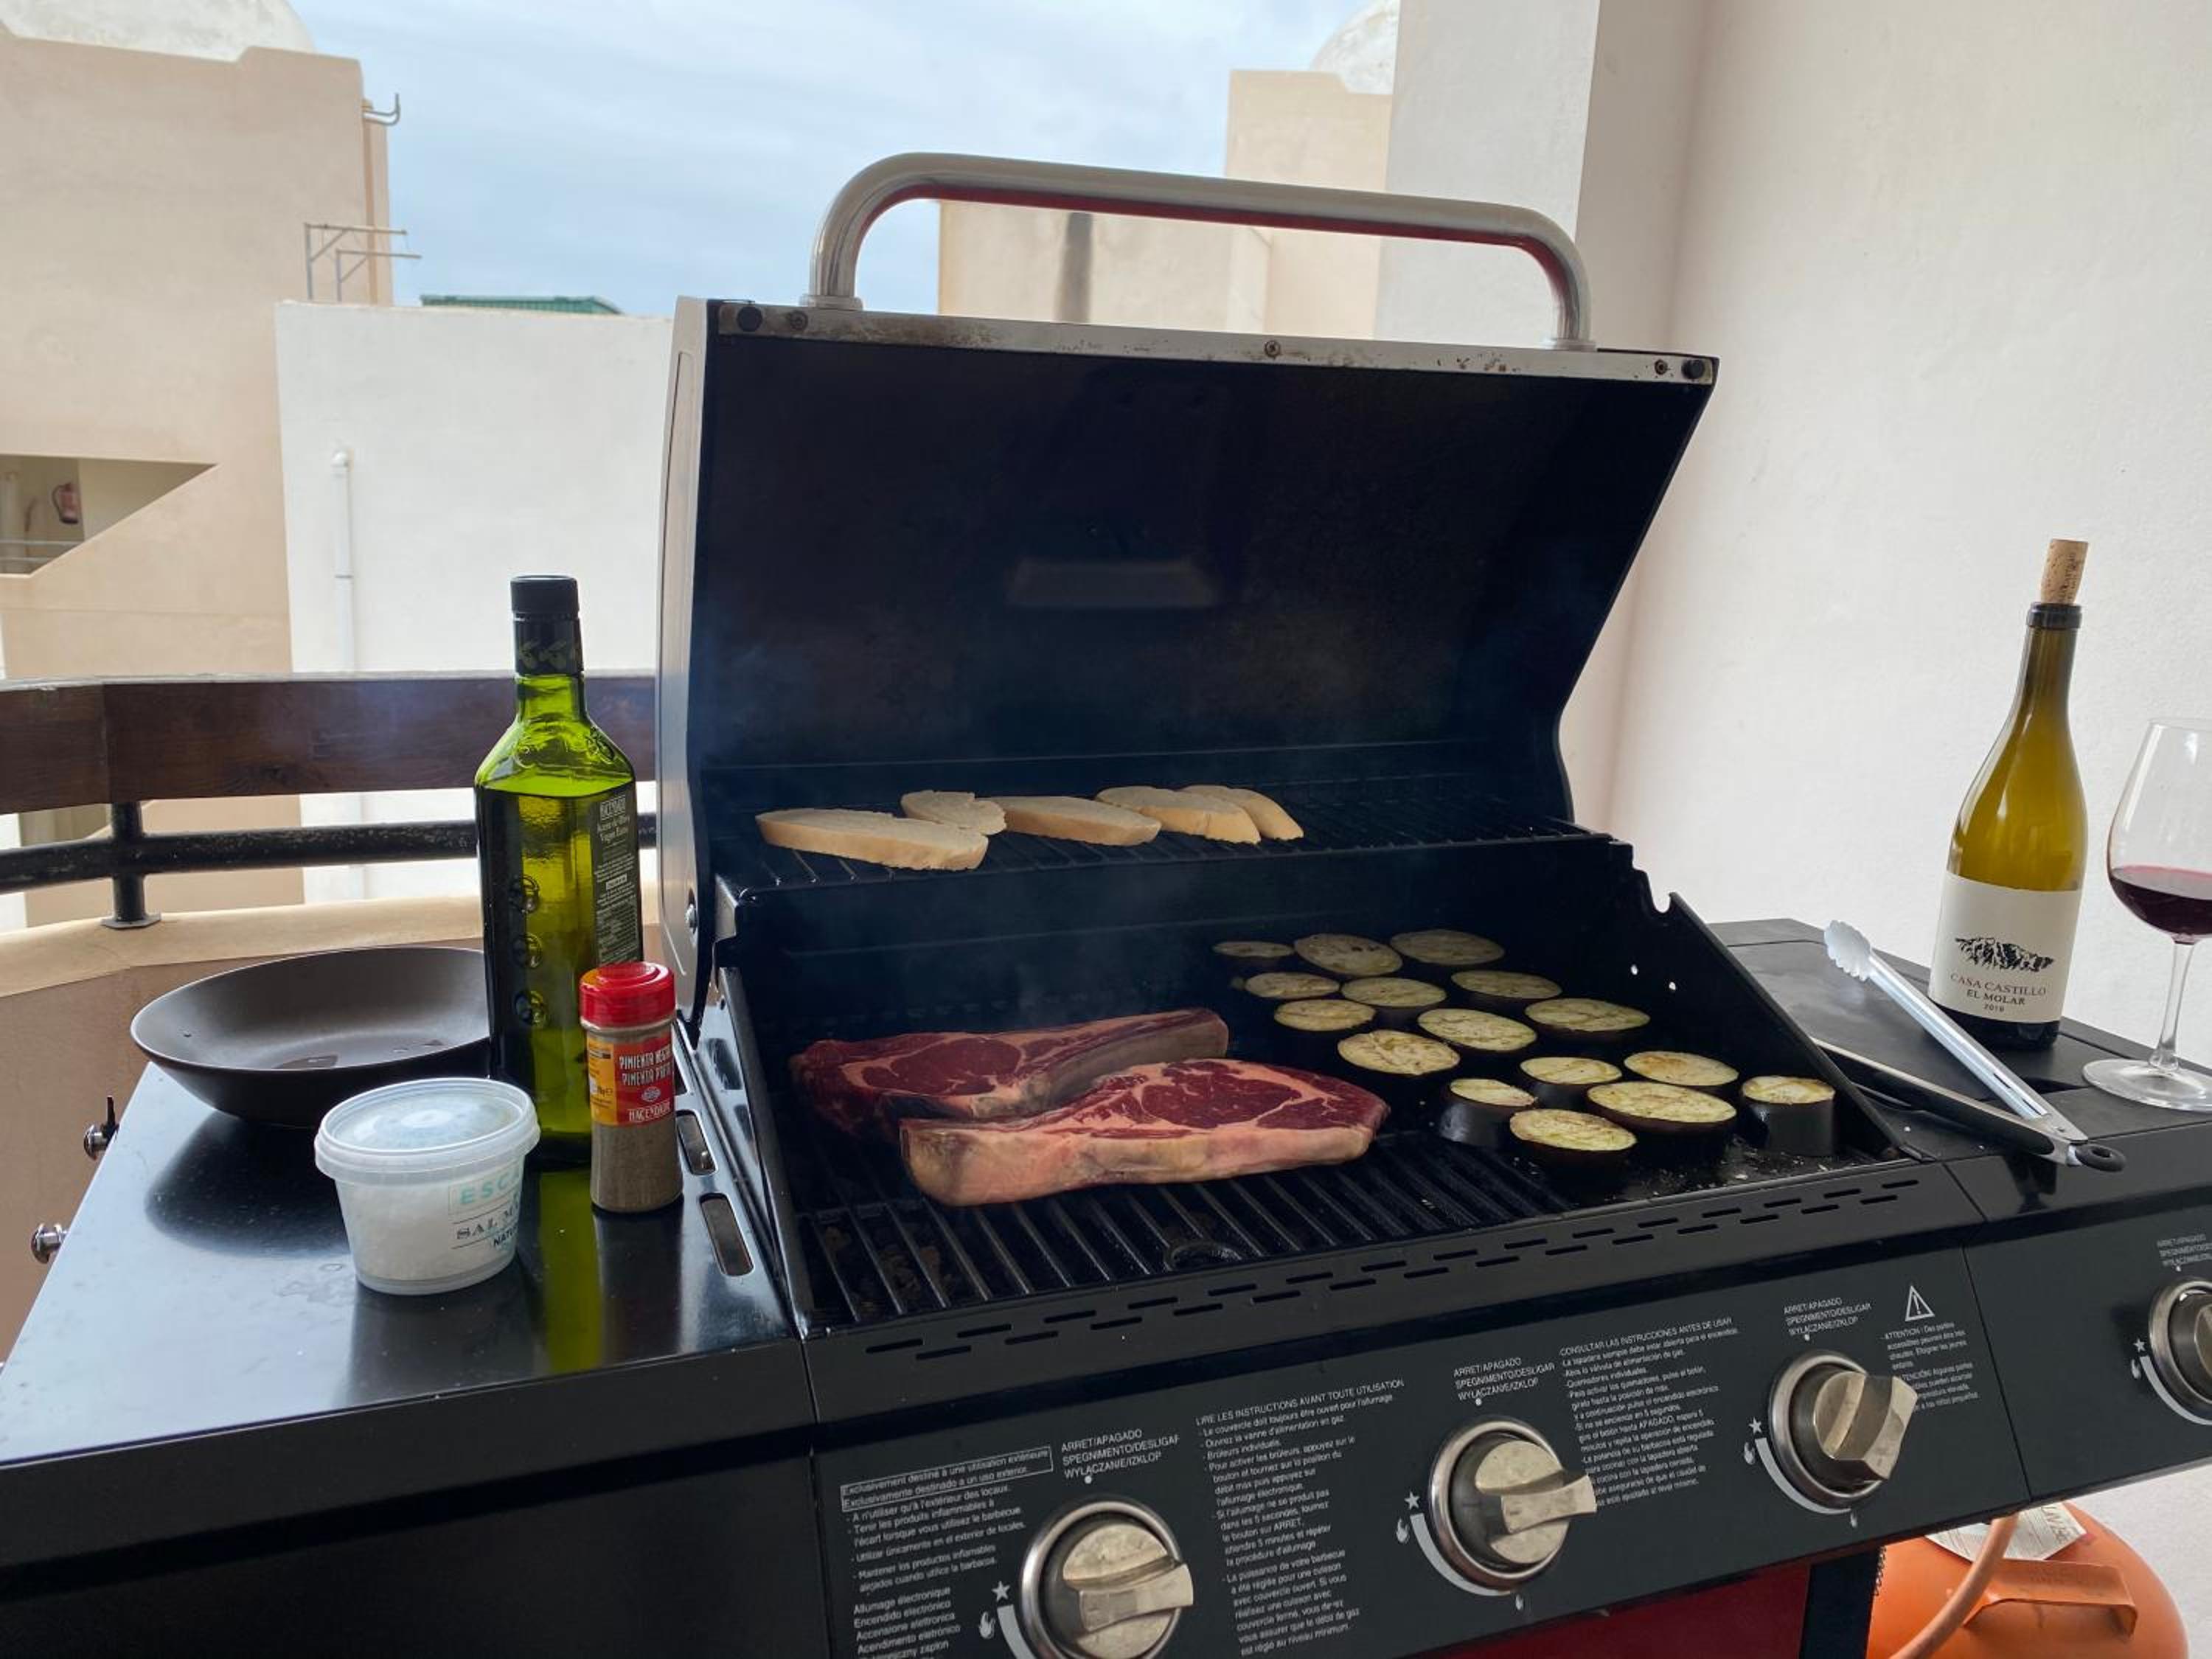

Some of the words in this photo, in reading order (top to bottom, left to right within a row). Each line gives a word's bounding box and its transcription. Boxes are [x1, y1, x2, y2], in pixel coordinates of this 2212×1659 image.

[1951, 973, 1981, 989] CASA
[1985, 981, 2046, 996] CASTILLO
[1966, 989, 1980, 998] EL
[1983, 992, 2025, 1005] MOLAR
[1061, 1428, 1142, 1453] ARRET/APAGADO
[1062, 1434, 1180, 1467] SPEGNIMENTO/DESLIGAR
